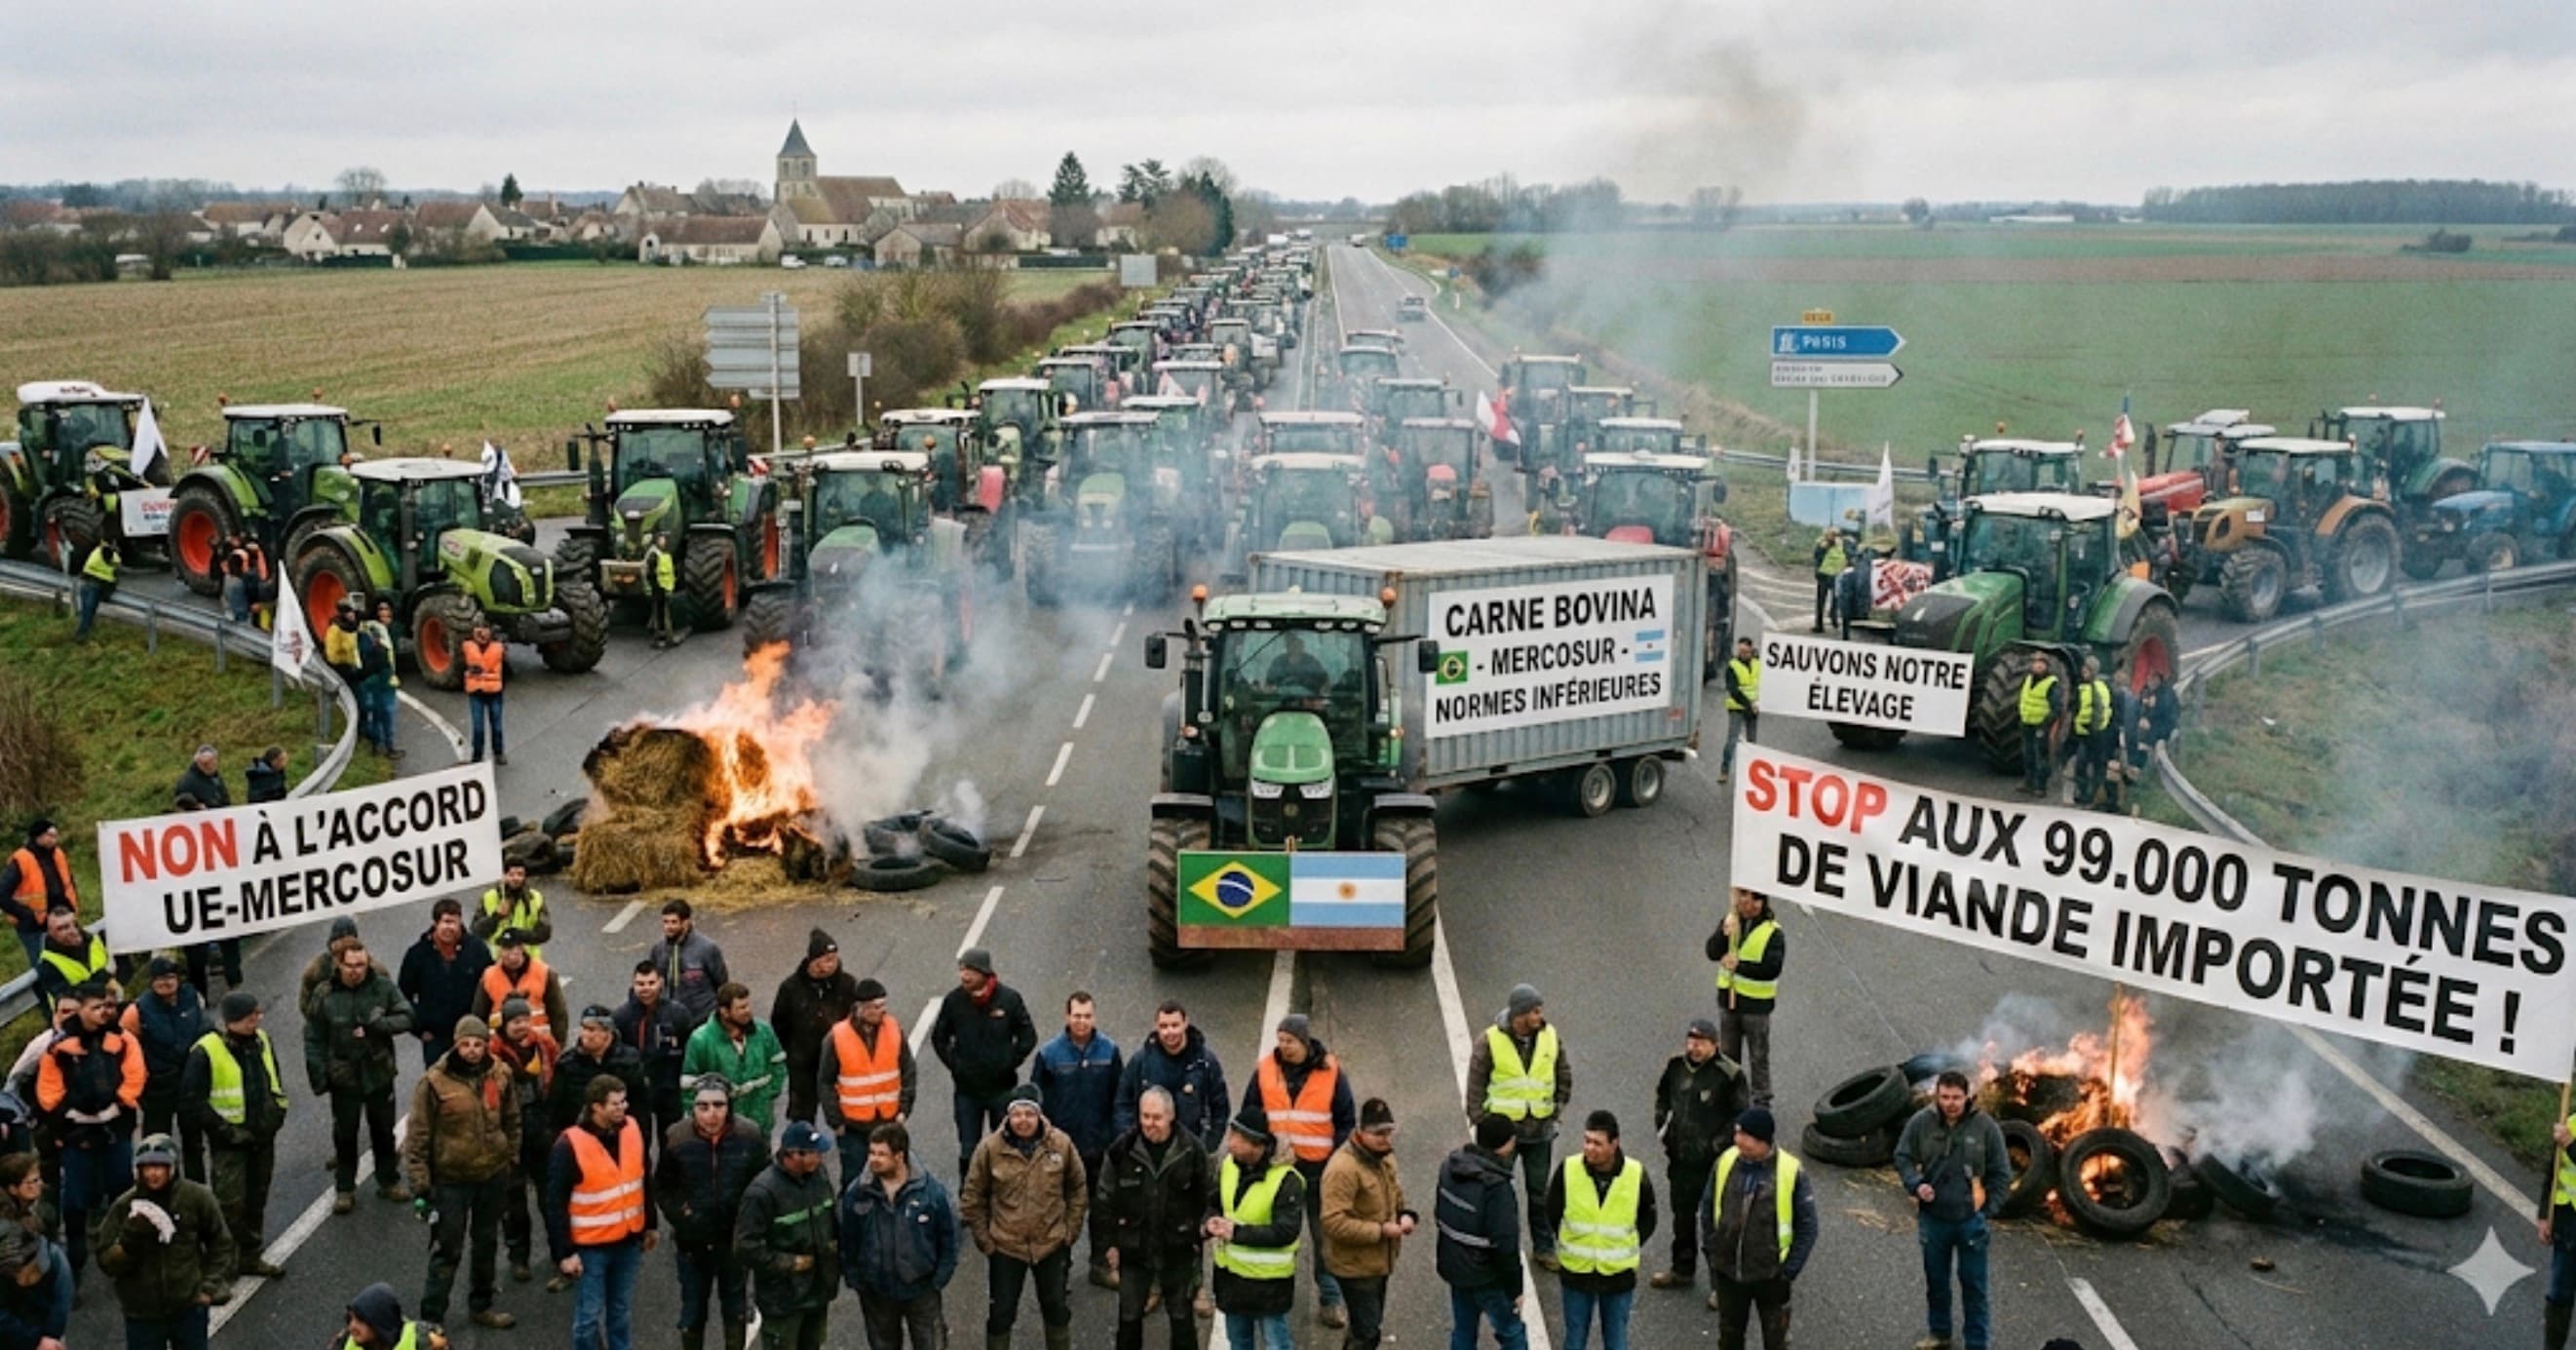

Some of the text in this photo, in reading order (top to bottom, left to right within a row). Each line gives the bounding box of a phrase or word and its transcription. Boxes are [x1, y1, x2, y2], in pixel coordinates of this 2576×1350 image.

[1446, 588, 1655, 637] CARNE BOVINA
[1492, 637, 1615, 675] MERCOSUR
[1766, 642, 1966, 689] SAUVONS NOTRE
[1437, 673, 1661, 723] NORMES INFÉRIEURES
[1808, 677, 1913, 721] ÉLEVAGE
[119, 780, 485, 883] NON À L'ACCORD
[164, 838, 470, 934] UE-MERCOSUR
[1746, 759, 2566, 975] STOP AUX 99.000 TONNES
[1777, 833, 2520, 1055] DE VIANDE IMPORTÉE !
